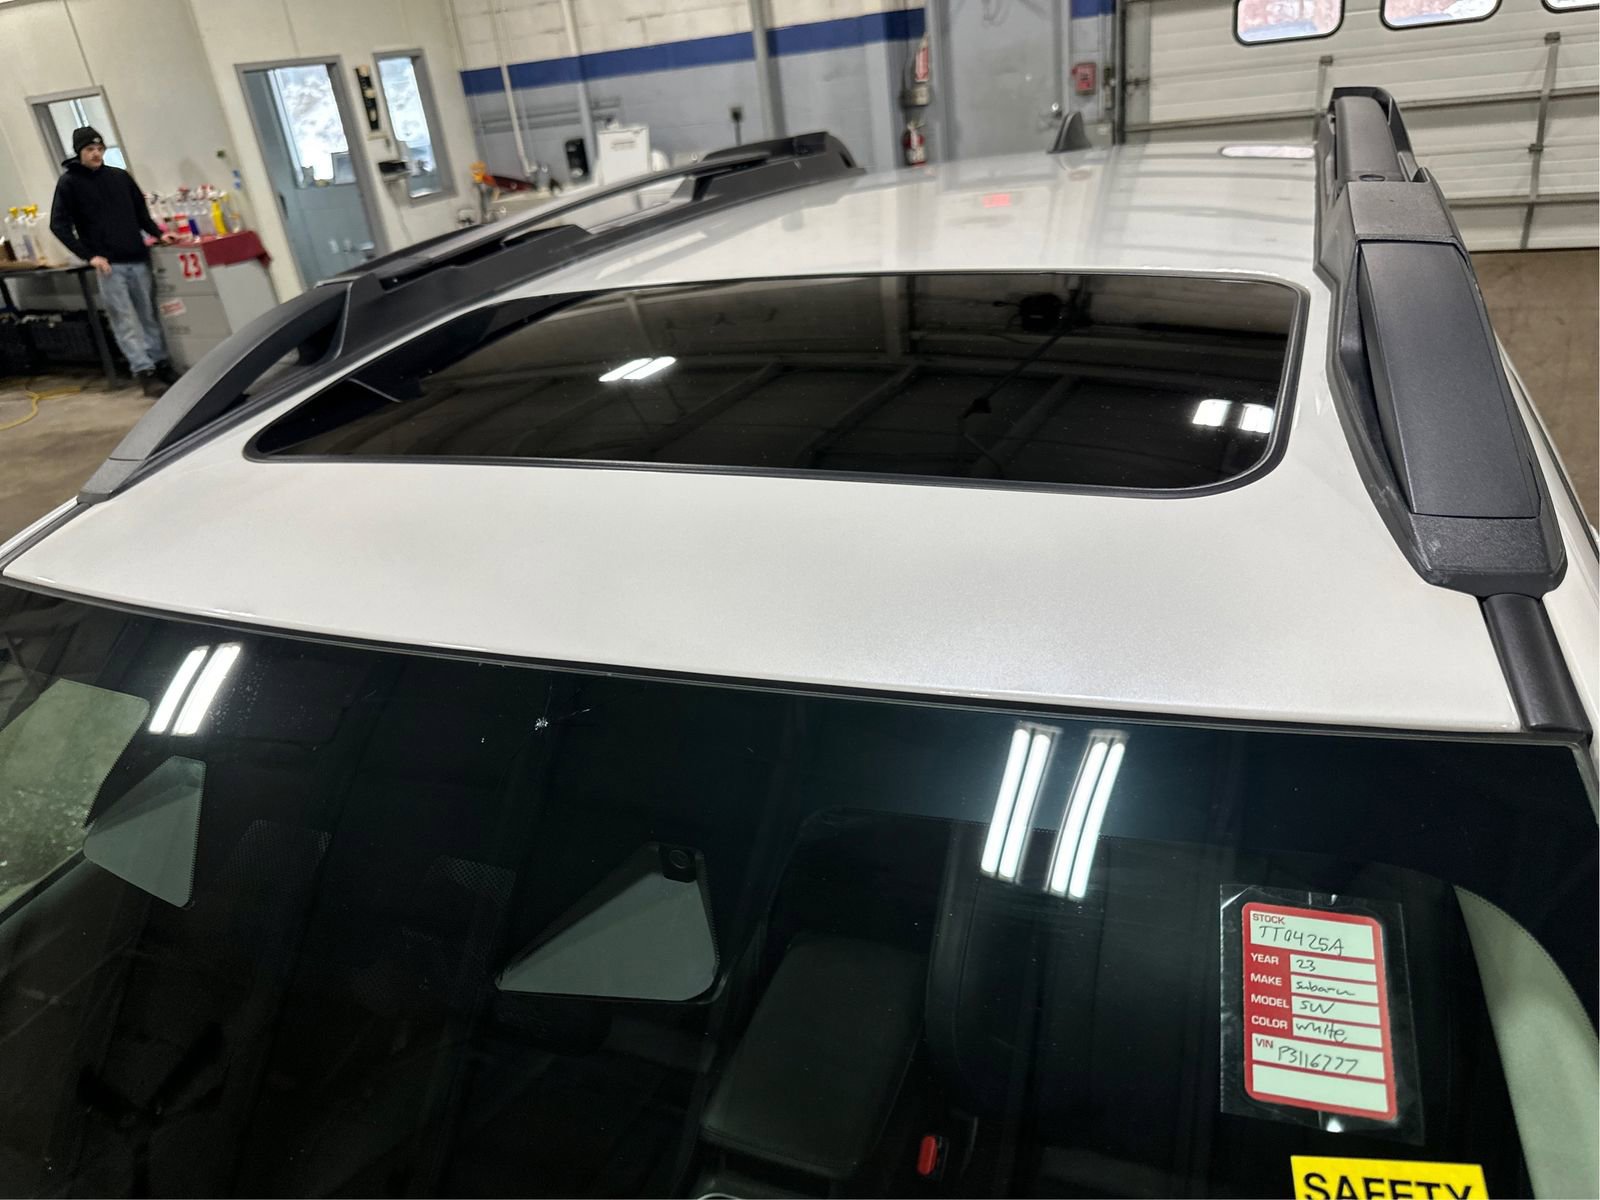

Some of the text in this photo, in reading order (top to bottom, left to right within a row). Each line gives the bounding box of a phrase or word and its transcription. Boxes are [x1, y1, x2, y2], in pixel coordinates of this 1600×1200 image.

[178, 253, 203, 279] 23
[1252, 913, 1285, 925] STOCK
[1259, 925, 1344, 956] TT0425A
[1250, 952, 1316, 972] YEAR 23
[1250, 973, 1283, 986] MAKE
[1250, 993, 1290, 1009] MODEL
[1251, 1015, 1288, 1030] COLOR
[1255, 1037, 1360, 1074] VIN P3116777
